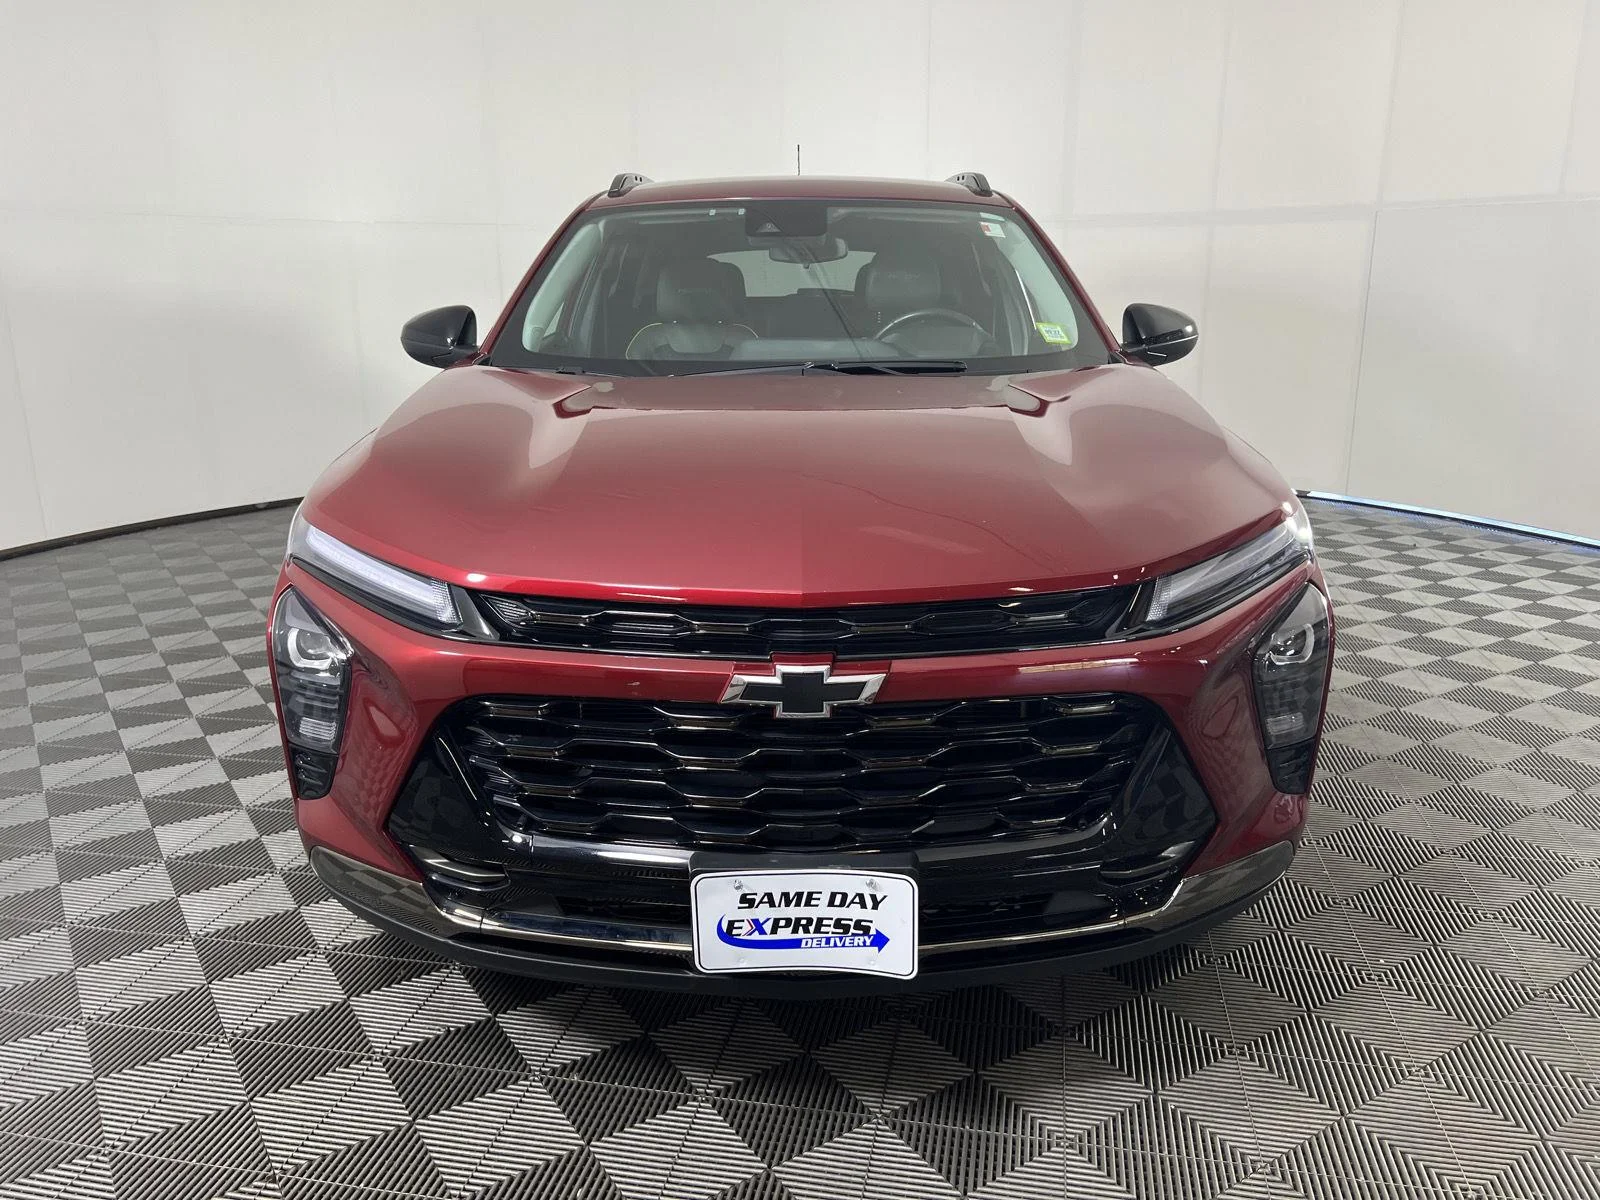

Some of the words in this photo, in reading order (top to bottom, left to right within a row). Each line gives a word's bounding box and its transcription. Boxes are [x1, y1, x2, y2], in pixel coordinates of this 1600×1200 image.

[737, 891, 822, 910] SAME
[827, 892, 888, 911] DAY
[726, 916, 873, 936] EXPRESS
[801, 935, 874, 948] DELIVERY
